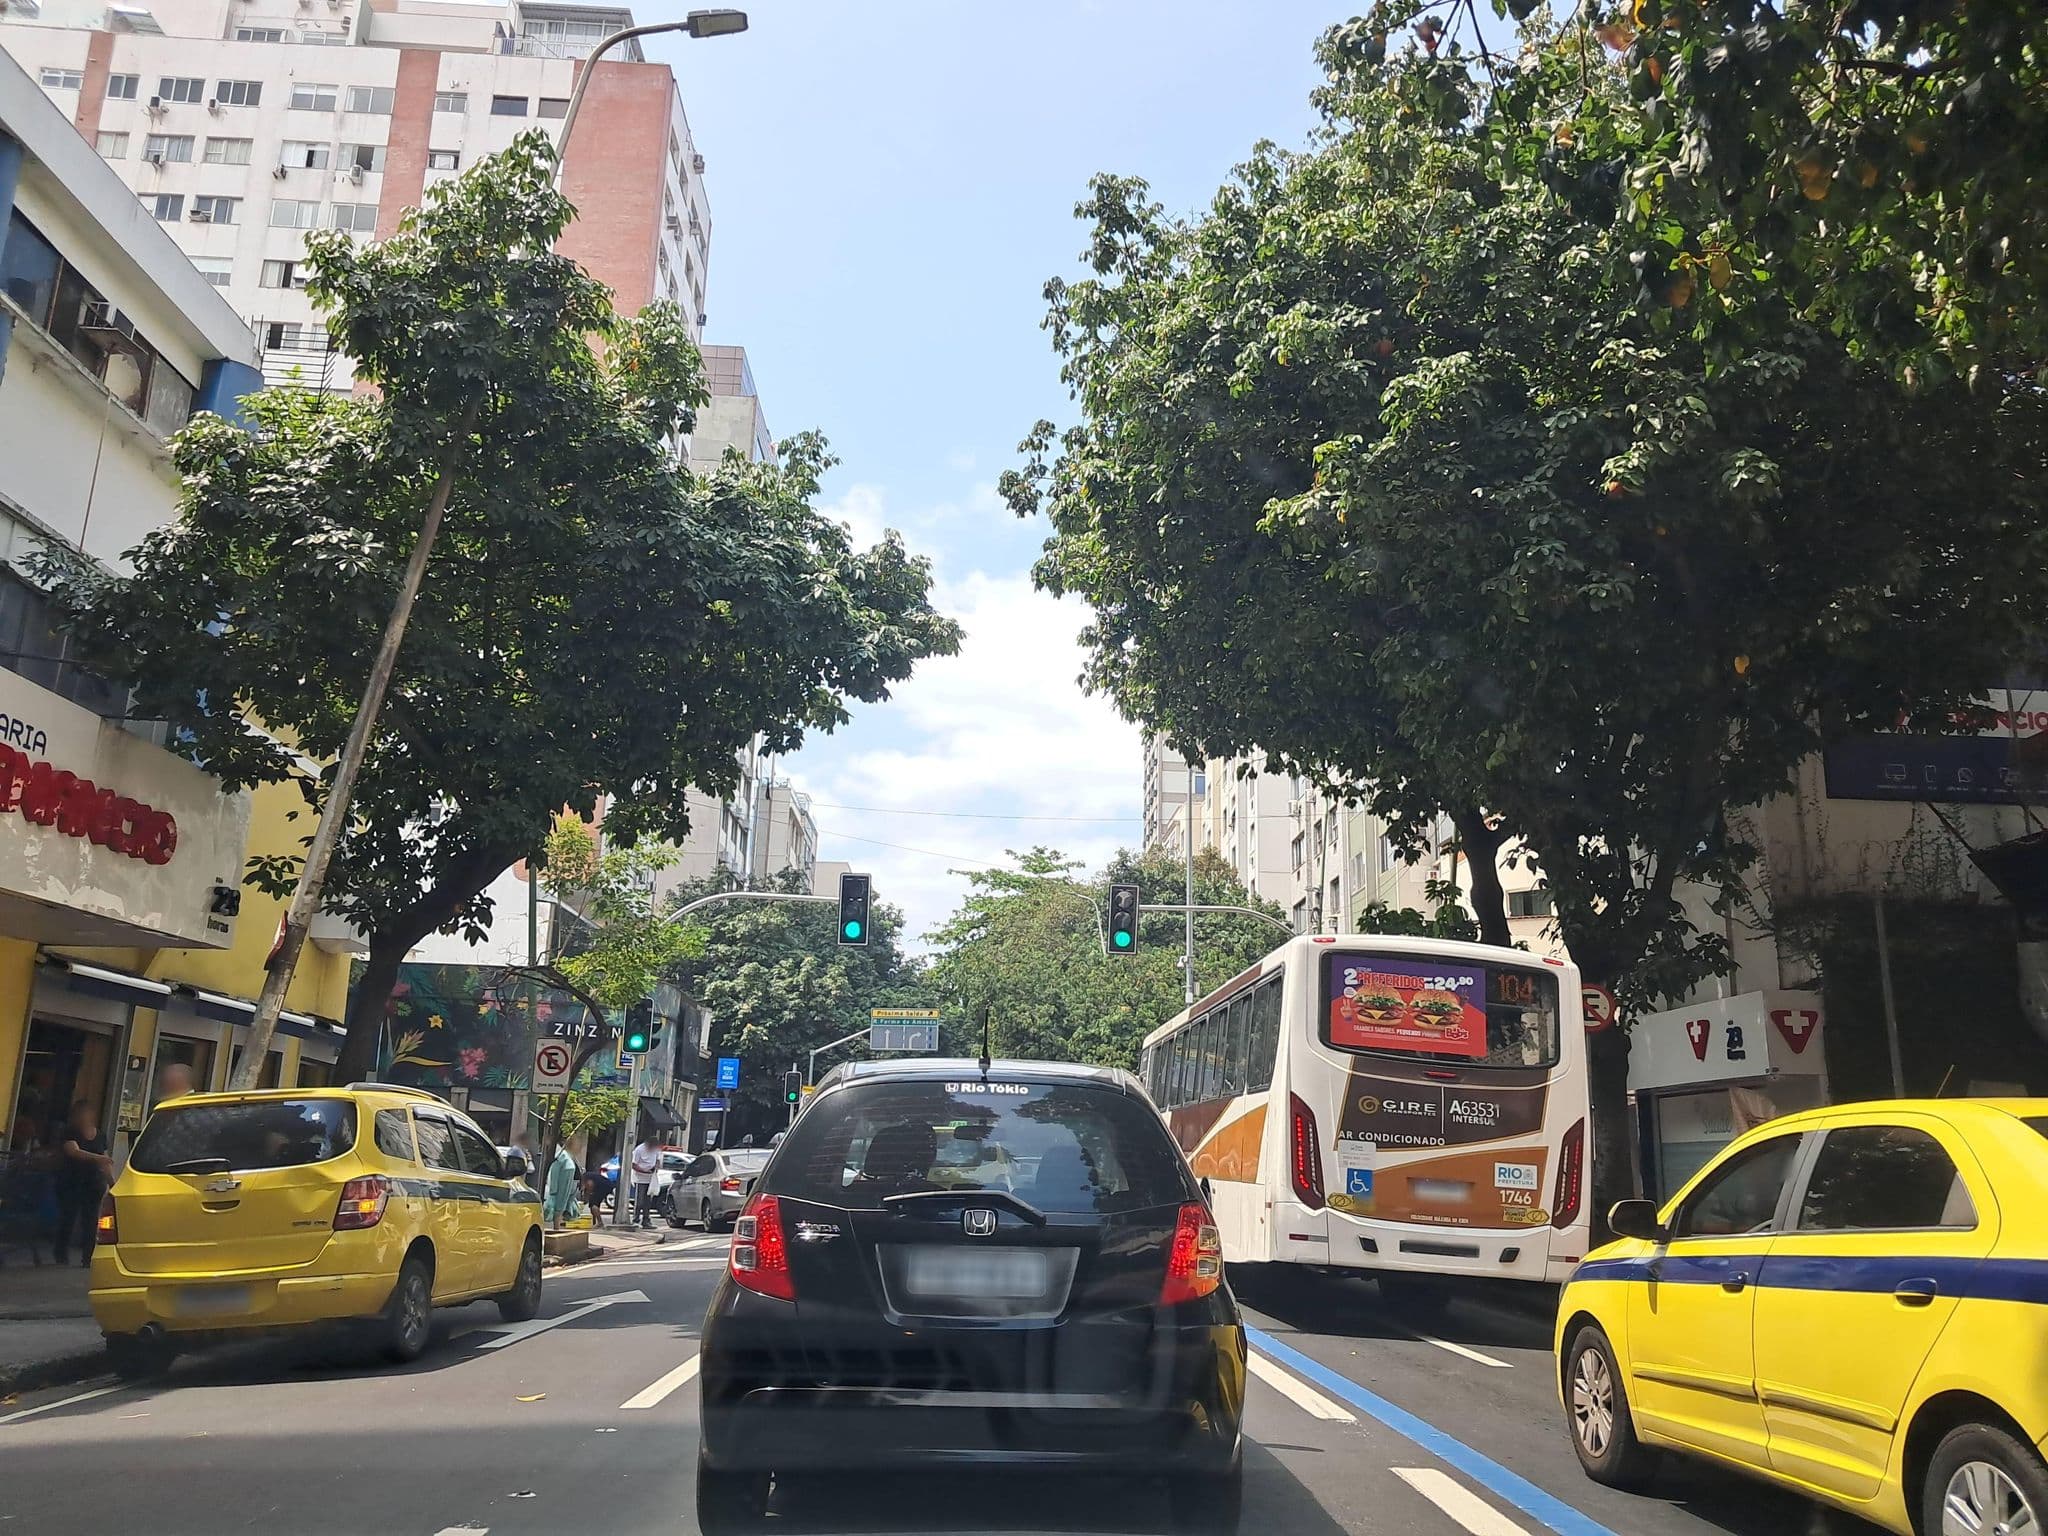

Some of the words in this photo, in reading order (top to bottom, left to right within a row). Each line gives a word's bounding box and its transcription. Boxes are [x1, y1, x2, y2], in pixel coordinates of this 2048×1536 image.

[1357, 972, 1424, 990] PREFERIDOS
[553, 1022, 621, 1039] ZINZN
[960, 1082, 986, 1093] Rio
[1382, 1100, 1437, 1112] GIRE
[1449, 1100, 1500, 1118] A63531
[1383, 1109, 1436, 1117] TRANSPORTES
[1453, 1114, 1496, 1126] INTERSUL
[1339, 1130, 1353, 1139] AR
[1358, 1131, 1446, 1146] CONDICIONADO
[1498, 1167, 1523, 1179] RIO
[1499, 1190, 1533, 1205] 1746
